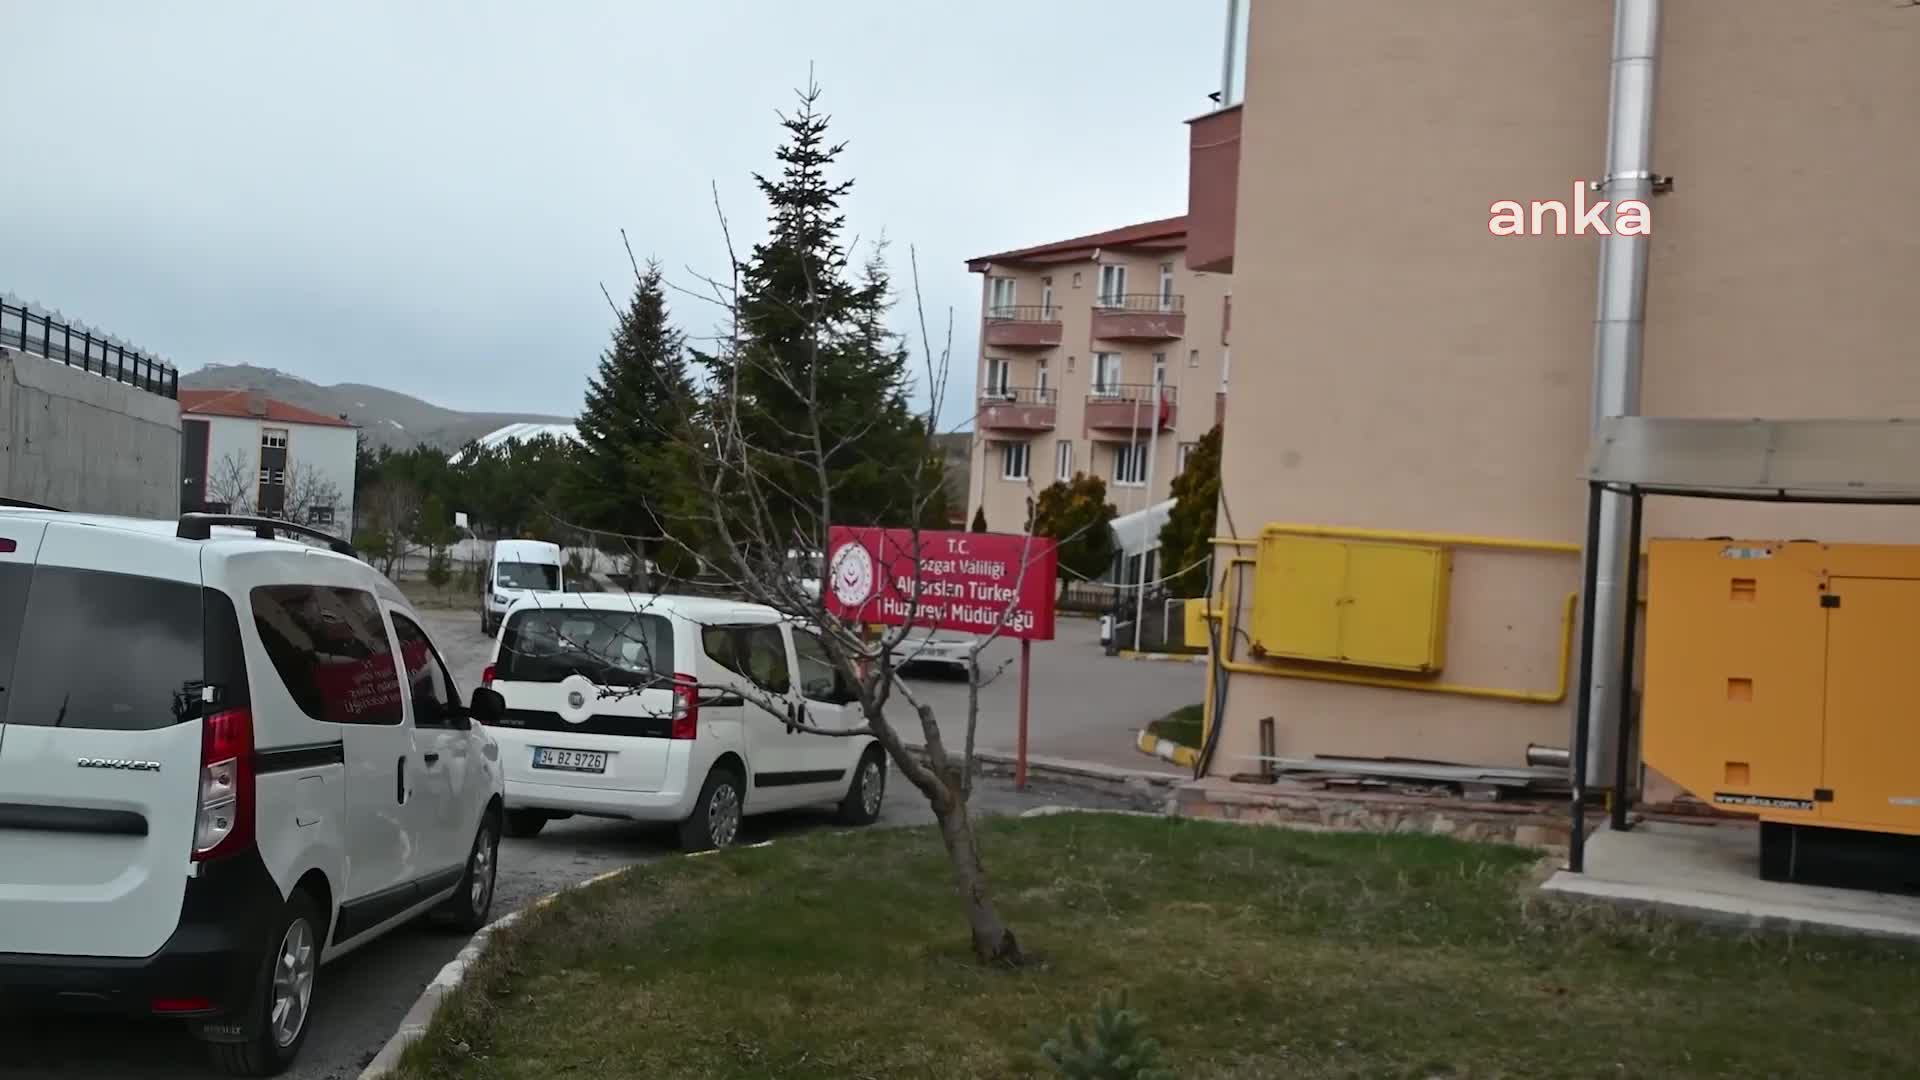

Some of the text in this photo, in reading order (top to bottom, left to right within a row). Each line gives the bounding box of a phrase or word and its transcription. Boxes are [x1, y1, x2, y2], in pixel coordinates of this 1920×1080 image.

[947, 539, 970, 554] T.C.
[913, 558, 1006, 580] ozgat Valiliği
[951, 603, 1034, 632] Müdürüğü
[77, 757, 161, 772] DOKKER
[542, 750, 602, 768] 34 BZ 9726
